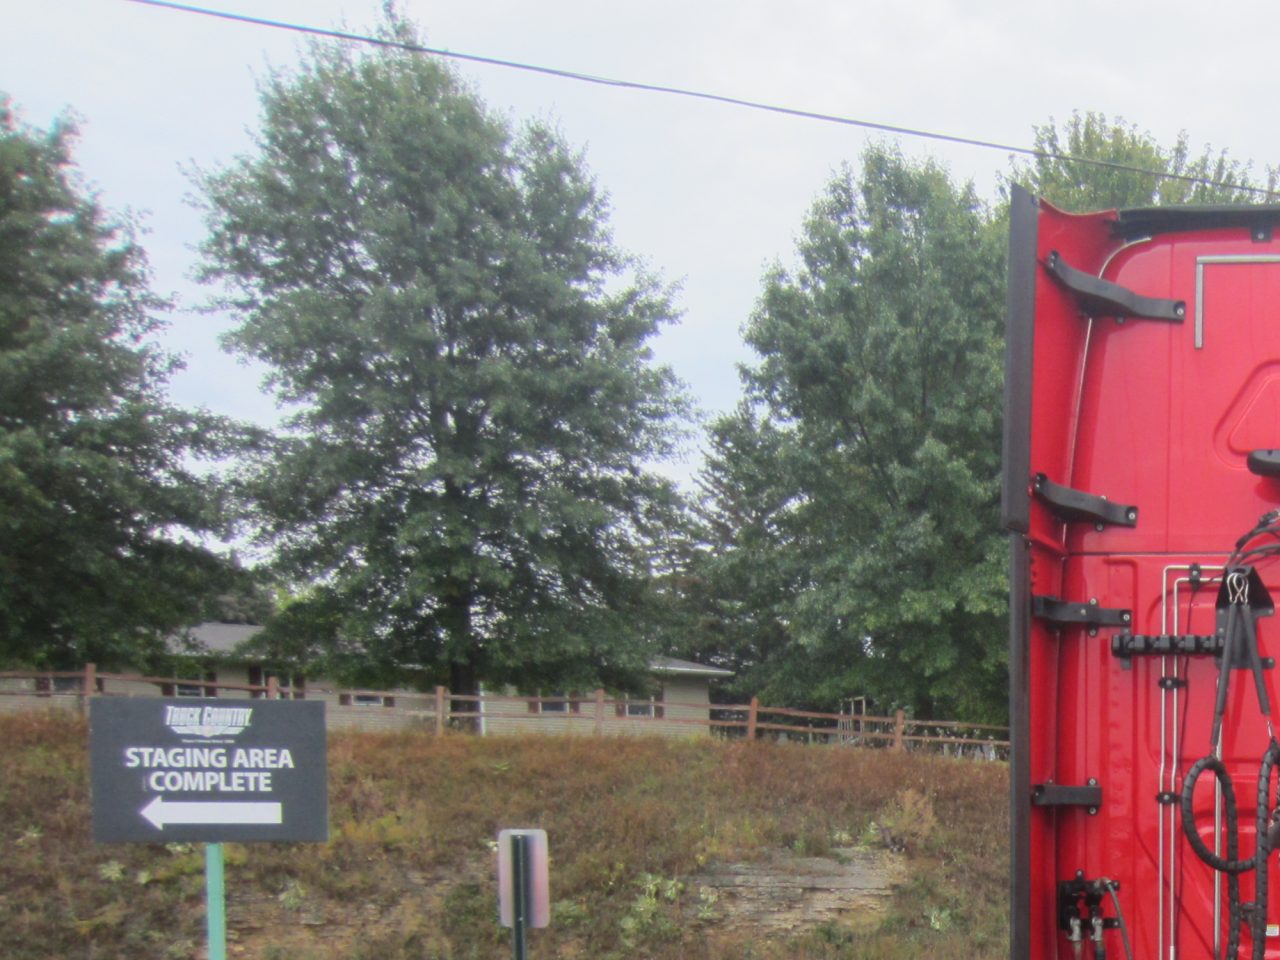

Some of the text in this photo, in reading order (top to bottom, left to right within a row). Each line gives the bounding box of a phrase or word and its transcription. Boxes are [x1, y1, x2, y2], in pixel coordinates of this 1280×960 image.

[126, 748, 294, 768] STAGING AREA
[150, 771, 272, 792] COMPLETE
